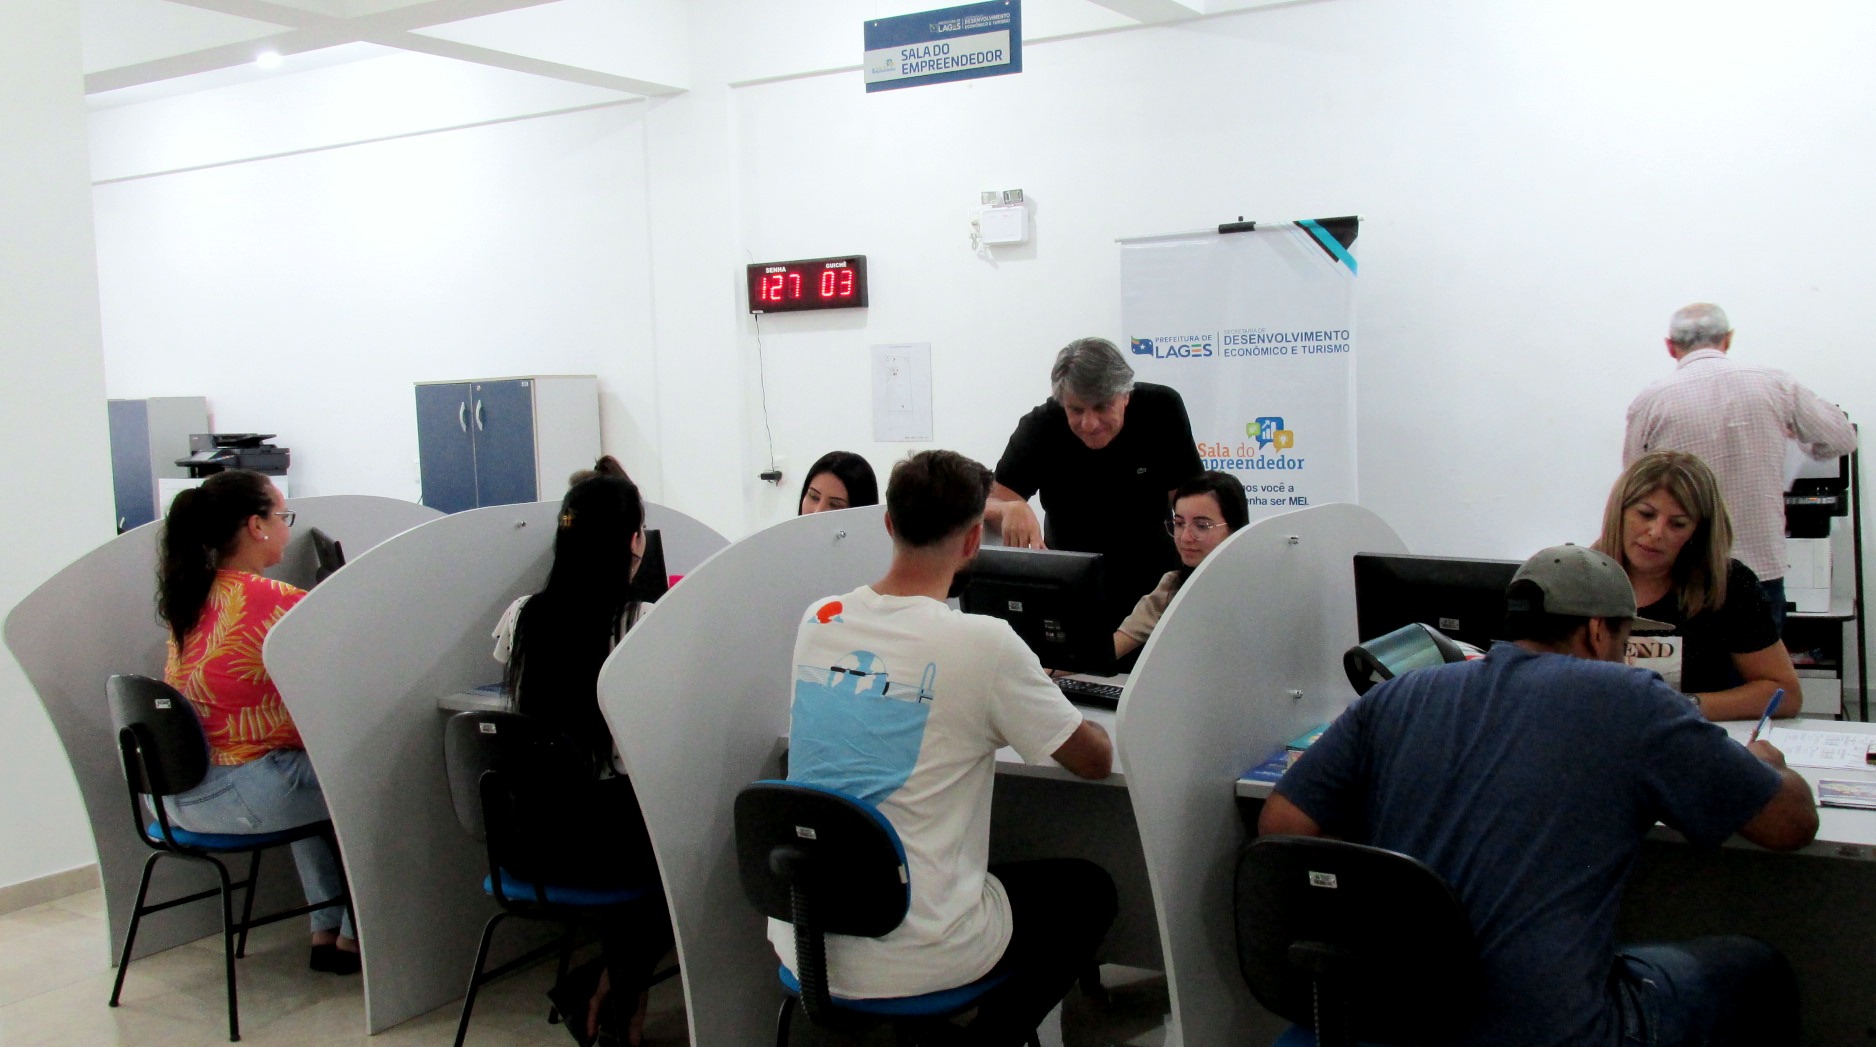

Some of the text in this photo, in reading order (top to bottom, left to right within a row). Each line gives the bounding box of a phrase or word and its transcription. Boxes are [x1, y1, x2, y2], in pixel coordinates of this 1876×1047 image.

[938, 22, 961, 33] LAGES
[901, 43, 950, 61] SALA DO
[901, 49, 1003, 75] EMPREENDEDOR
[765, 266, 786, 274] SENHA
[826, 260, 847, 269] GUICHÊ
[762, 273, 800, 300] 127
[821, 270, 853, 297] 03
[1155, 335, 1200, 343] PREFEITURA
[1224, 329, 1350, 346] DESENVOLVIMENTO
[1155, 343, 1213, 359] LAGES
[1224, 343, 1350, 358] ECONÔMICO E TURISMO
[1197, 442, 1255, 458] Sala do
[1199, 454, 1305, 471] preendedor
[1261, 482, 1285, 493] você
[1287, 485, 1294, 493] a
[1270, 498, 1287, 506] ser
